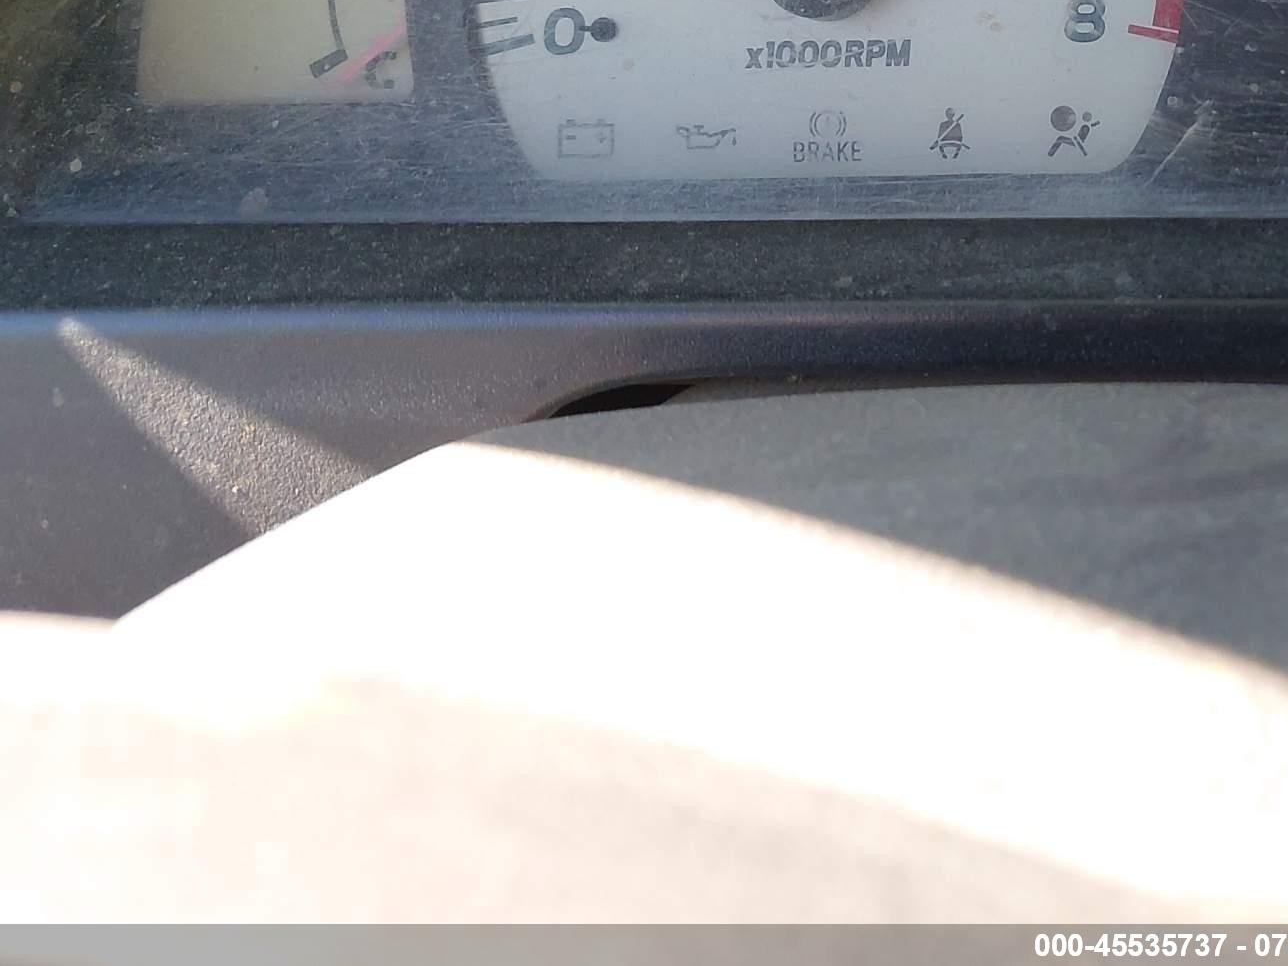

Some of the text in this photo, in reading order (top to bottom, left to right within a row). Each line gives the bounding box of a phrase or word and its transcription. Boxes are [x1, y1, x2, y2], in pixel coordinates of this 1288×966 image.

[544, 7, 586, 55] 0
[365, 51, 397, 90] C
[744, 40, 912, 70] x1000RPM
[793, 141, 863, 163] BRAKE
